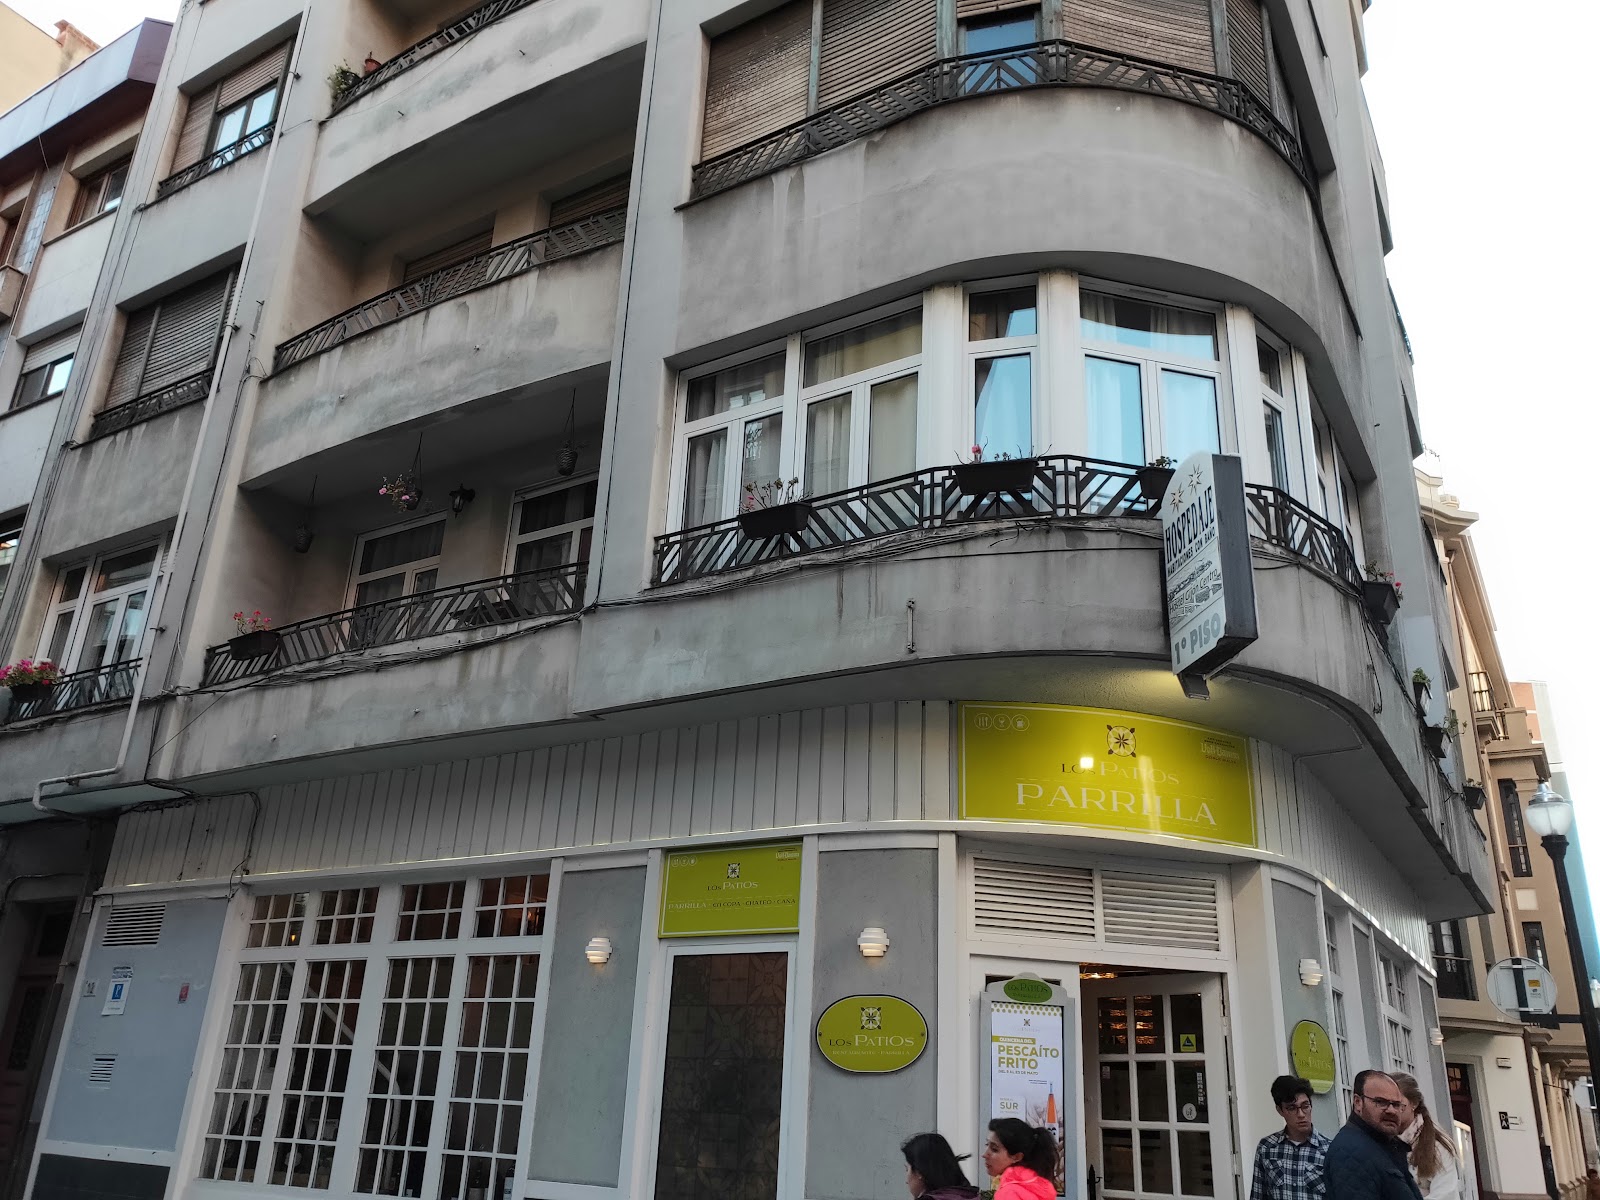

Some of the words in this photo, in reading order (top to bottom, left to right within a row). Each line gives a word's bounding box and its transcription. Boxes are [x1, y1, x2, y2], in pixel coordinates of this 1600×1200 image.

[1165, 485, 1215, 564] HOSPEDAJE
[1200, 568, 1218, 590] Centro
[1189, 612, 1221, 655] PISO
[1016, 783, 1217, 826] PARRILLA
[723, 881, 759, 890] PATIOS
[668, 902, 707, 910] PARRILLA
[829, 1038, 852, 1047] LOS
[855, 1034, 915, 1047] PATIOS
[998, 1045, 1059, 1058] PESCAÍTO
[998, 1056, 1039, 1070] FRITO
[1000, 1101, 1019, 1110] SUR
